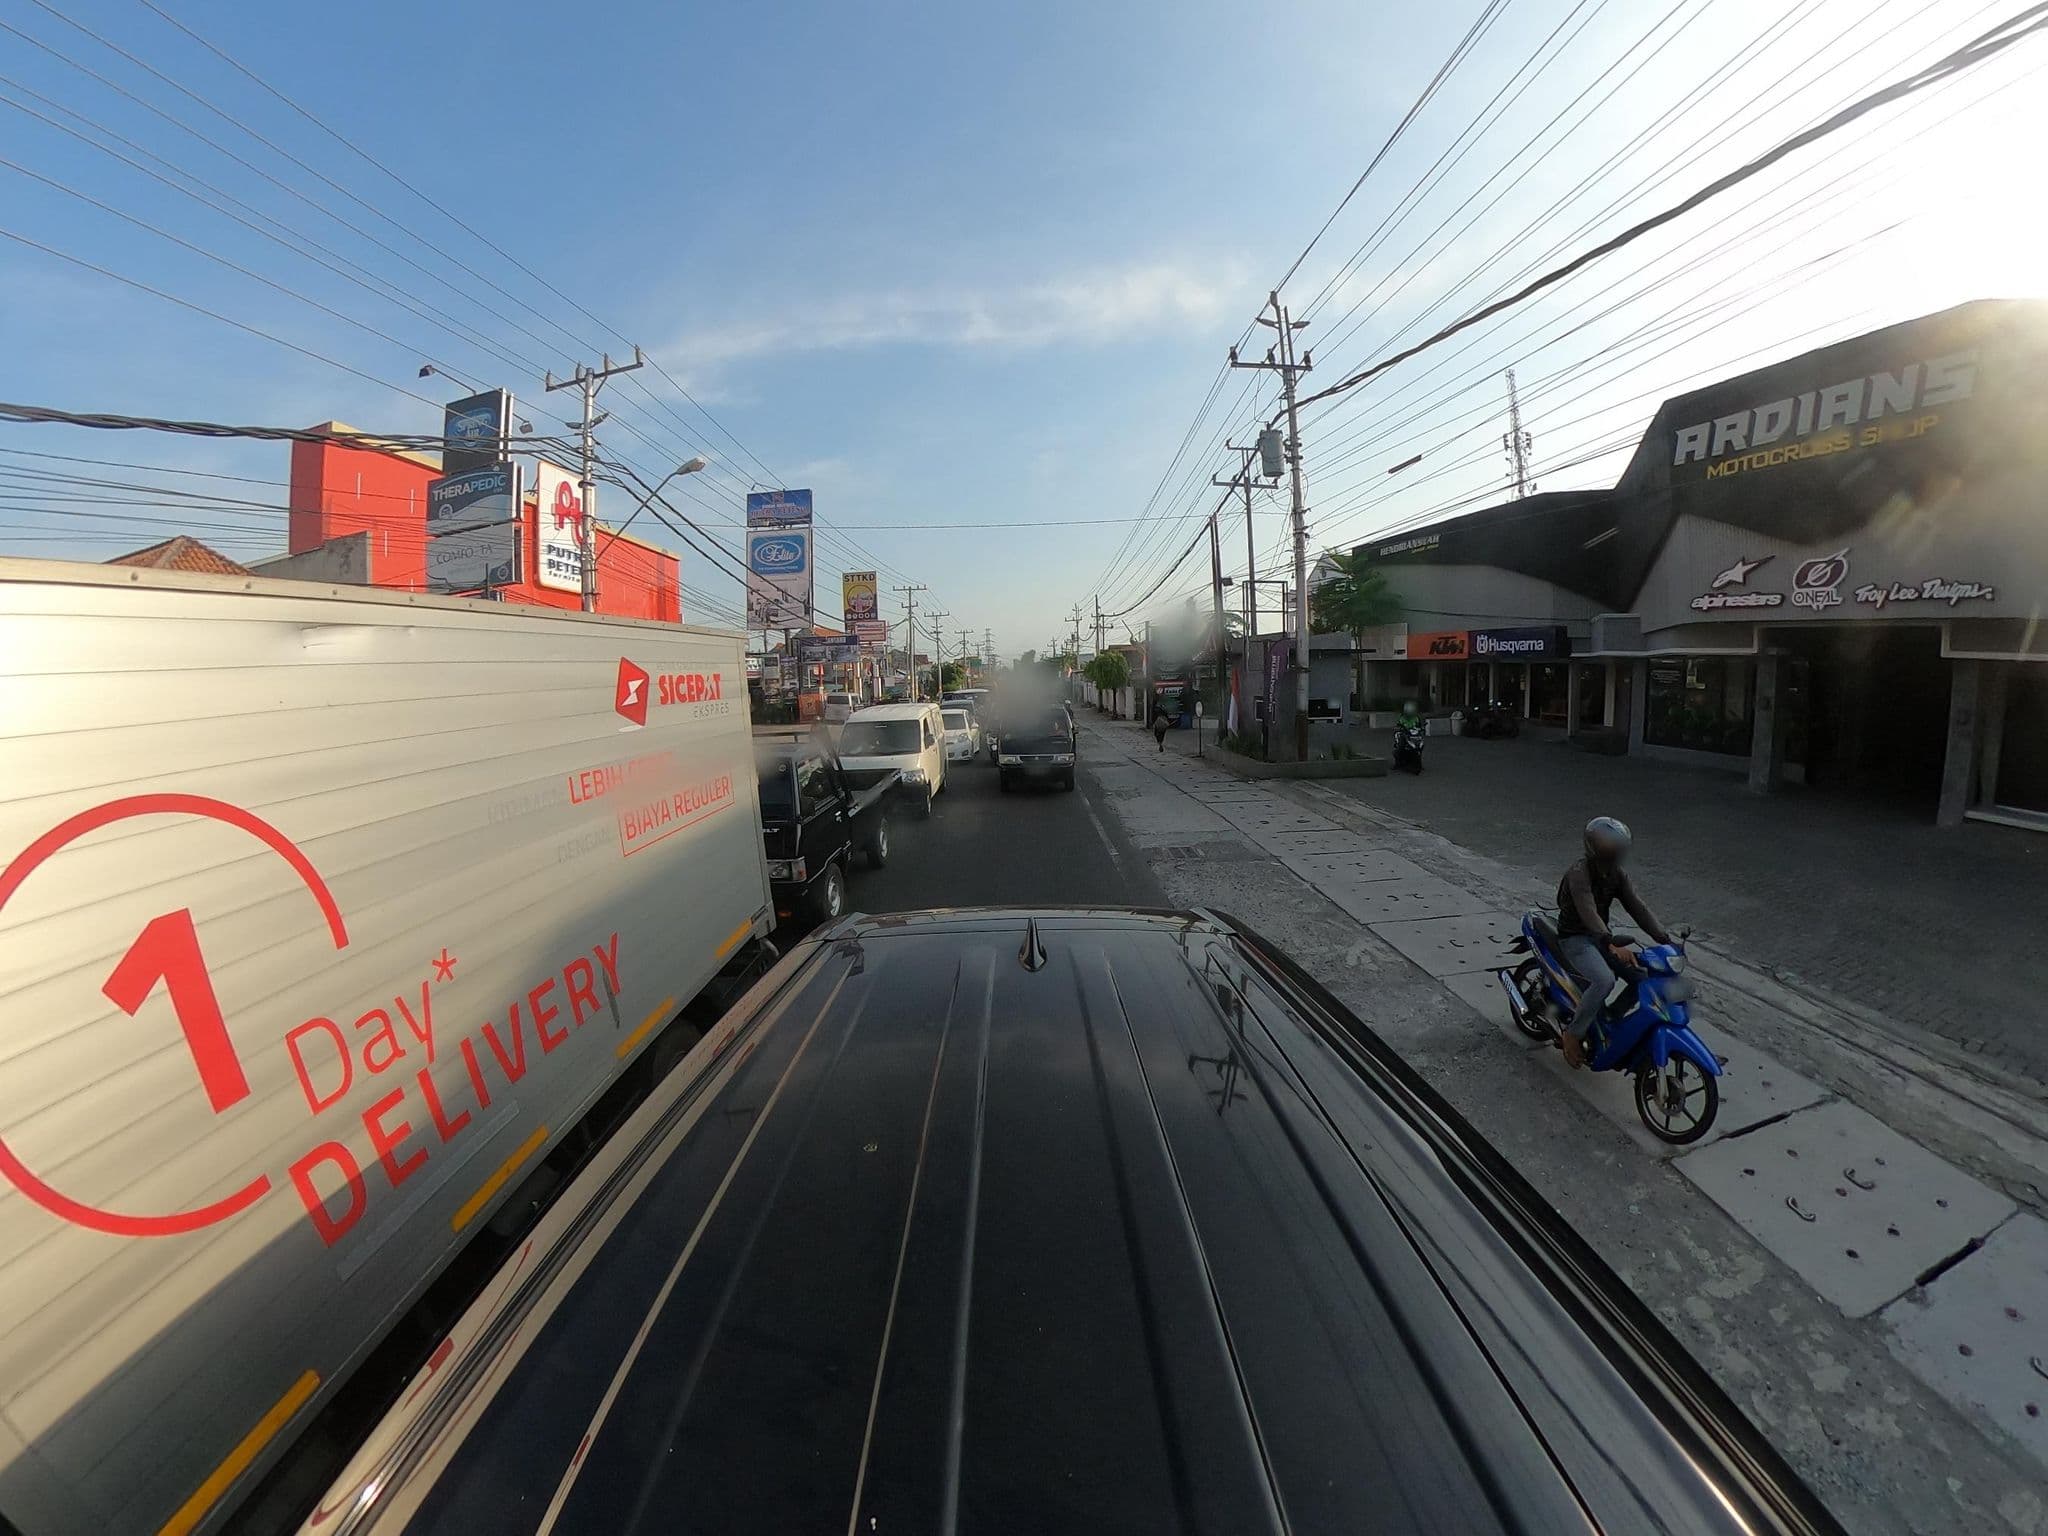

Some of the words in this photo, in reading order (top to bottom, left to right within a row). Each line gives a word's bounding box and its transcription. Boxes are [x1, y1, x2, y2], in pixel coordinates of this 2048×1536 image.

[1673, 353, 1978, 466] ARDIANS
[1707, 431, 1850, 480] MOTOCROSS
[1860, 415, 1938, 447] SOP
[432, 474, 508, 502] THERAPEDIC
[436, 545, 493, 565] COMFOTA
[547, 544, 582, 562] PUTR
[547, 559, 582, 575] BETE
[844, 573, 875, 583] STTKD
[1691, 593, 1782, 610] alpinestars
[1856, 583, 1887, 608] Troy
[1888, 582, 1918, 600] Lee
[1429, 637, 1465, 655] KTM
[1489, 639, 1544, 654] Husqvarna
[658, 673, 721, 705] SICEPAT
[693, 702, 730, 718] EKSPRES
[624, 802, 672, 841] BIAYA
[674, 776, 730, 824] REGULER
[102, 908, 251, 1114] 1
[288, 932, 622, 1248] DELIVERY
